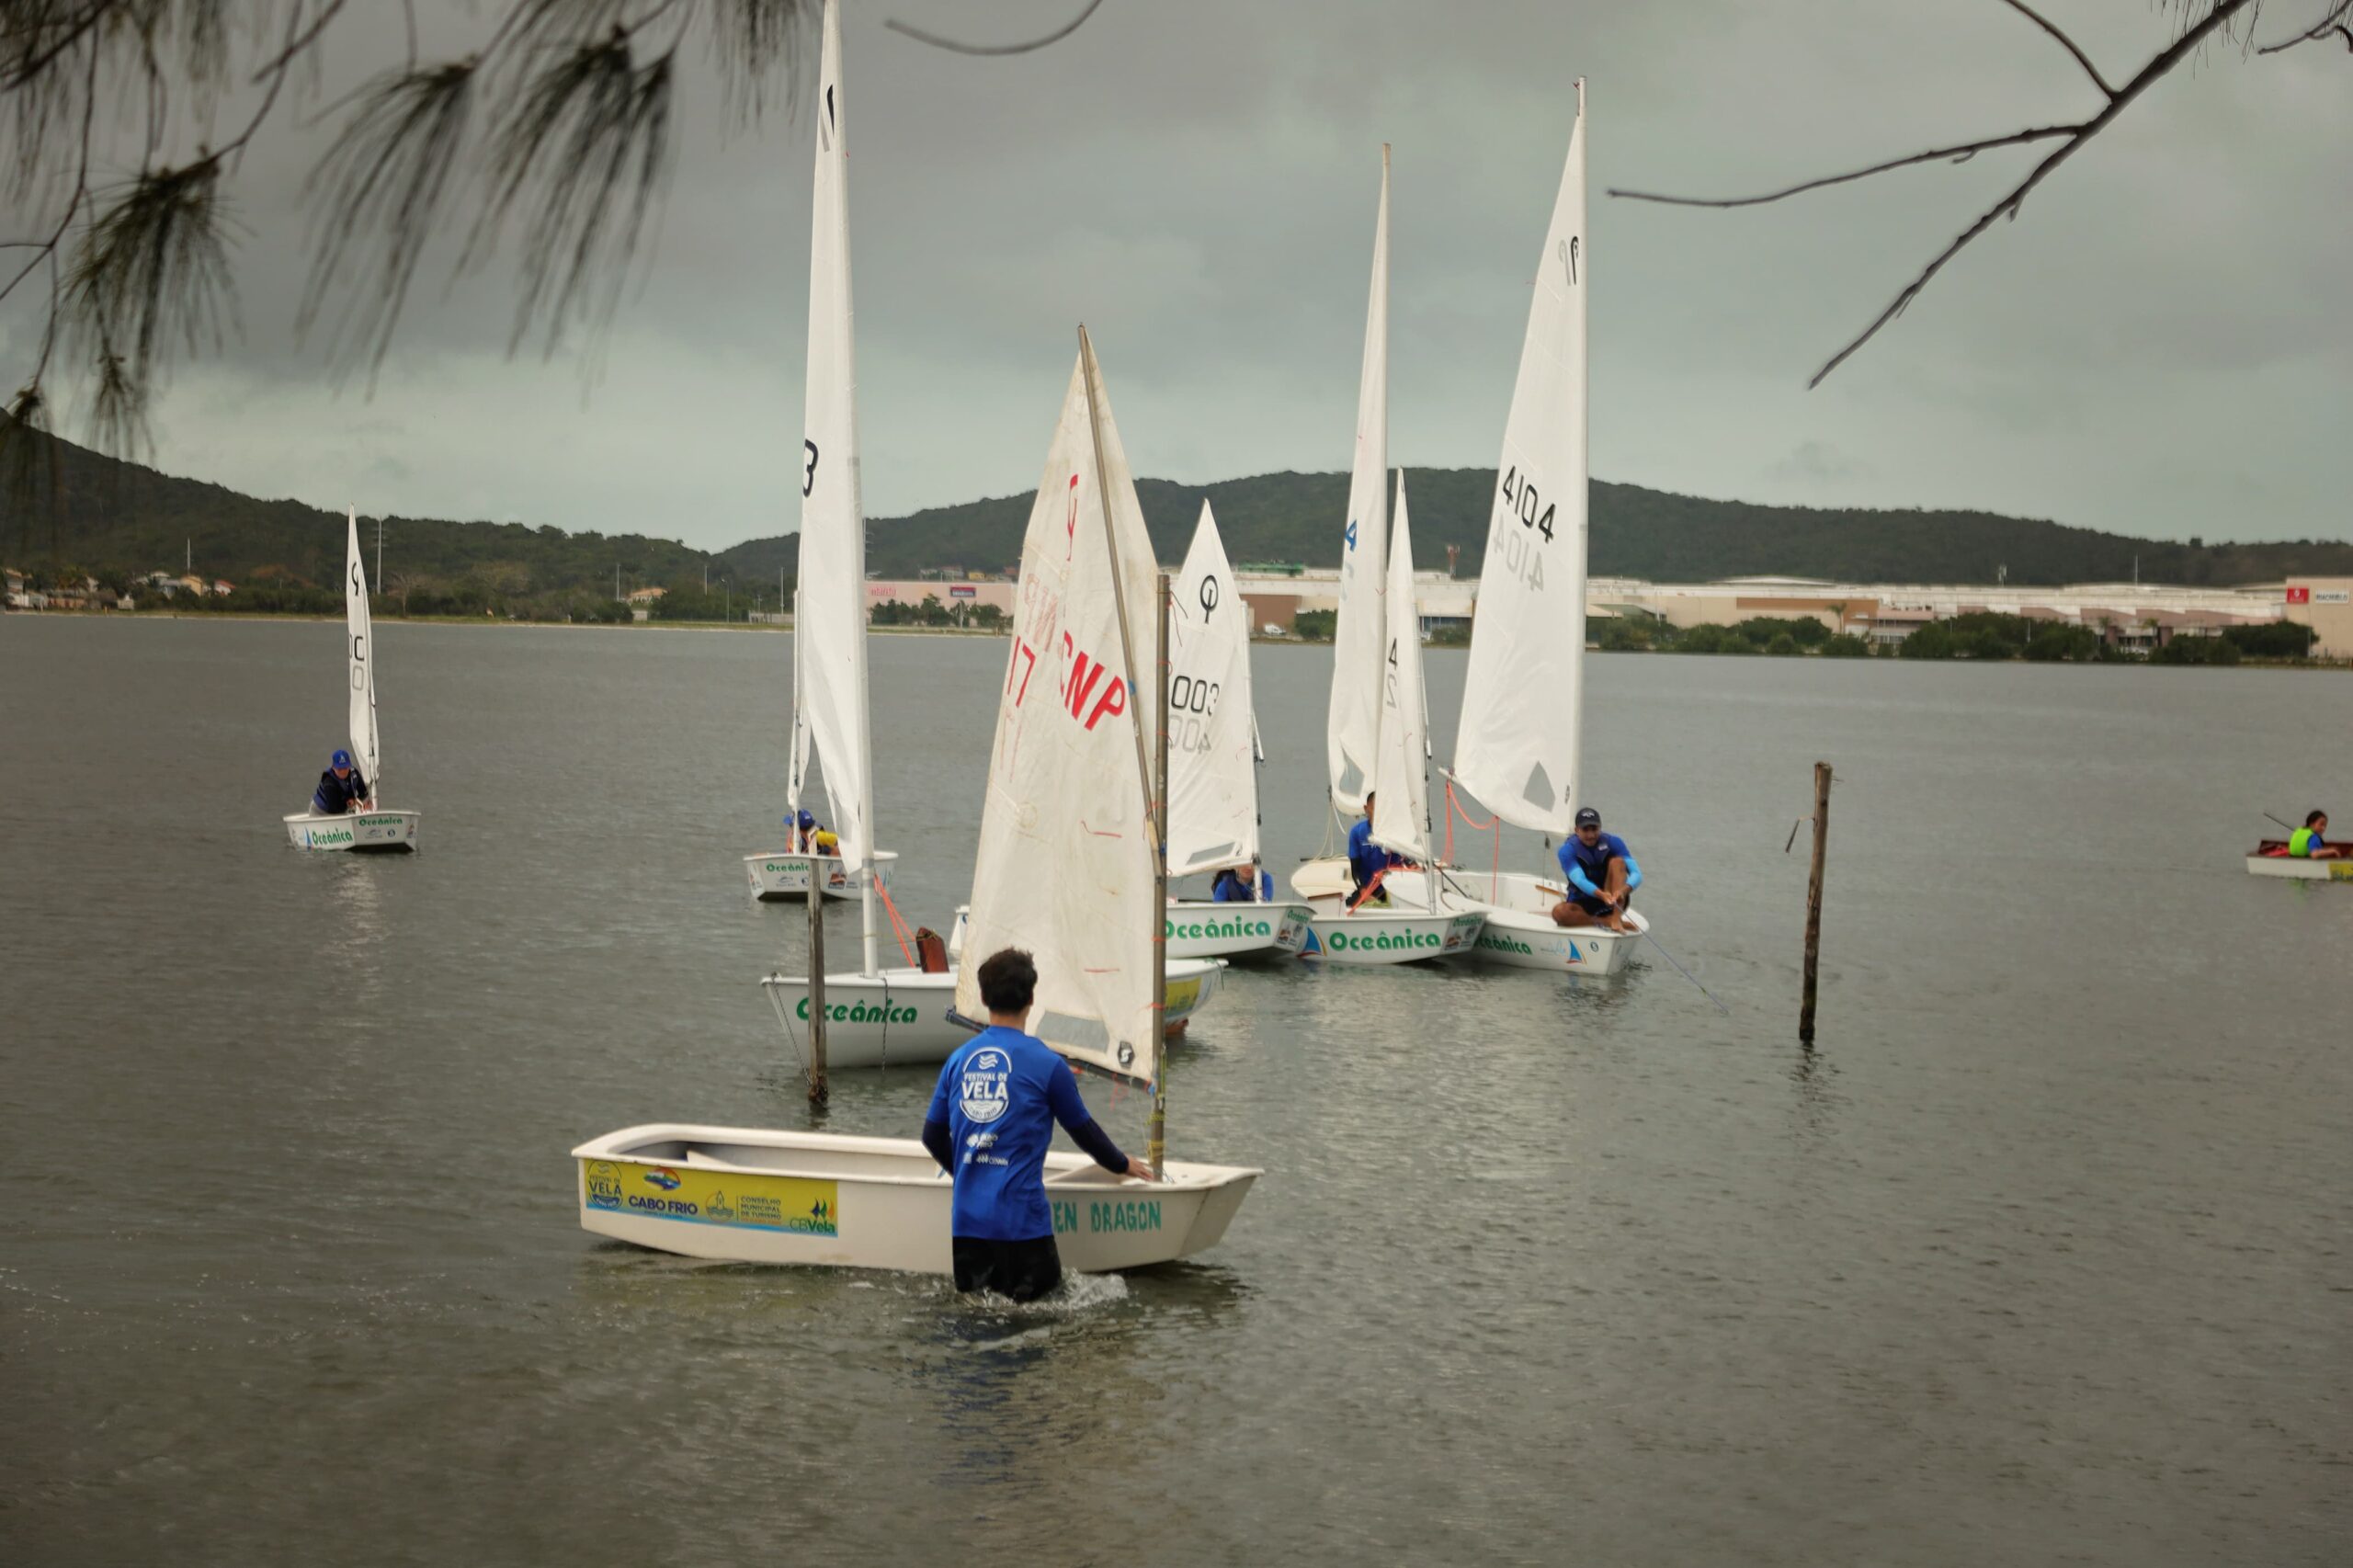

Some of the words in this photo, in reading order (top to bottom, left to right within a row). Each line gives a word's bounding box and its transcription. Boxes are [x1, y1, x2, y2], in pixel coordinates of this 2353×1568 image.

[1503, 465, 1556, 544] 4104
[1329, 928, 1441, 951] Oceânica
[963, 1073, 995, 1082] FESTIVAL
[997, 1074, 1007, 1082] DE
[961, 1082, 1008, 1100] VELA
[588, 1180, 622, 1196] VELA
[628, 1196, 665, 1210] CABO
[667, 1200, 699, 1215] FRIO
[790, 1217, 835, 1233] CBVela
[1091, 1200, 1162, 1233] DRAGON
